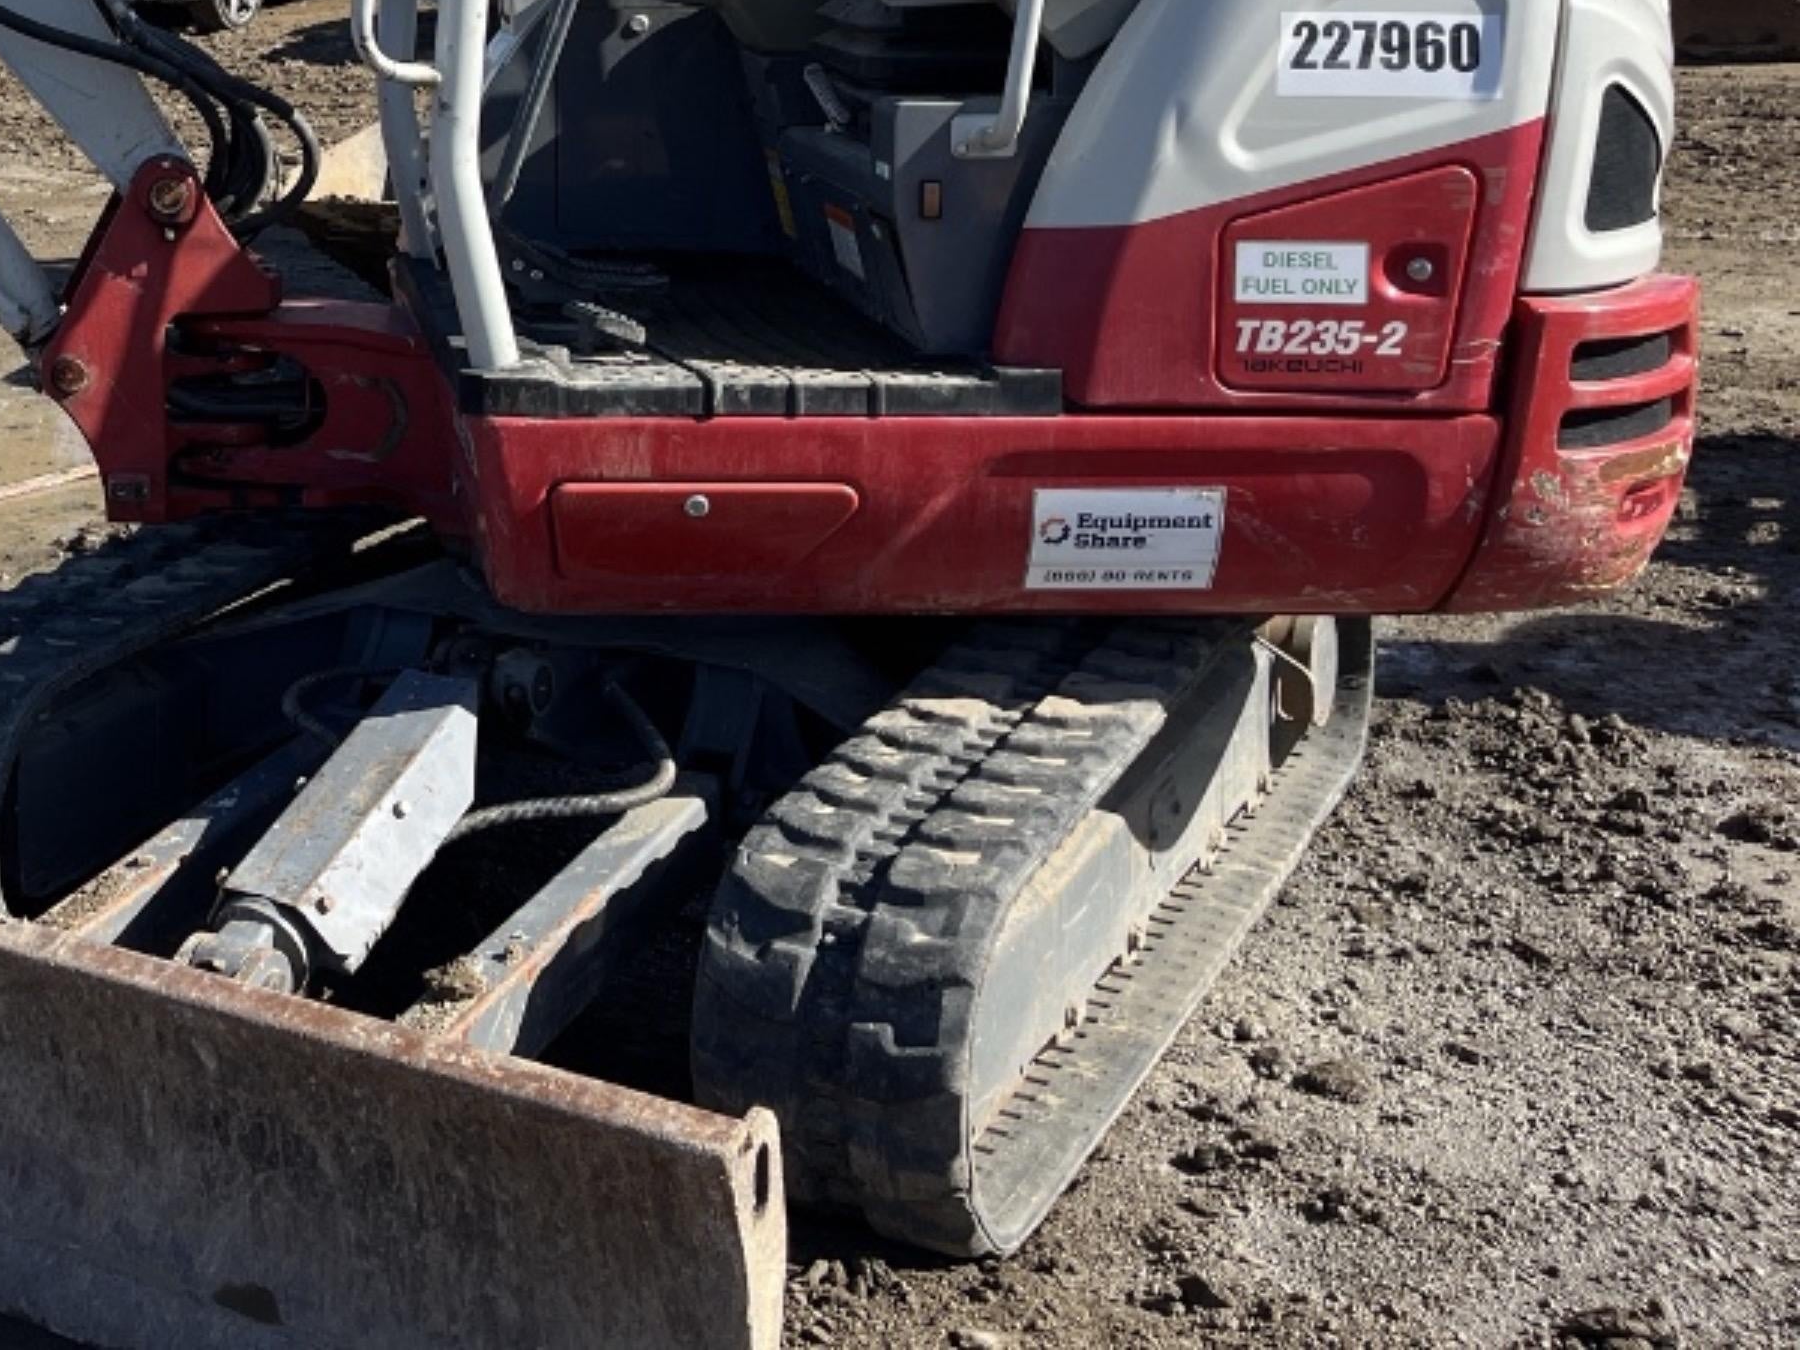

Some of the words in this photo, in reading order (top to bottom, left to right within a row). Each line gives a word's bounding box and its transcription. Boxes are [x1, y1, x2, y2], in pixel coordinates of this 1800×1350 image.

[1290, 20, 1480, 72] 227960
[1263, 252, 1338, 269] DIESEL
[1242, 278, 1296, 295] FUEL
[1302, 278, 1359, 295] ONLY
[1236, 319, 1407, 355] TB235-2
[1076, 513, 1213, 532] Equipment
[1073, 533, 1147, 549] Share
